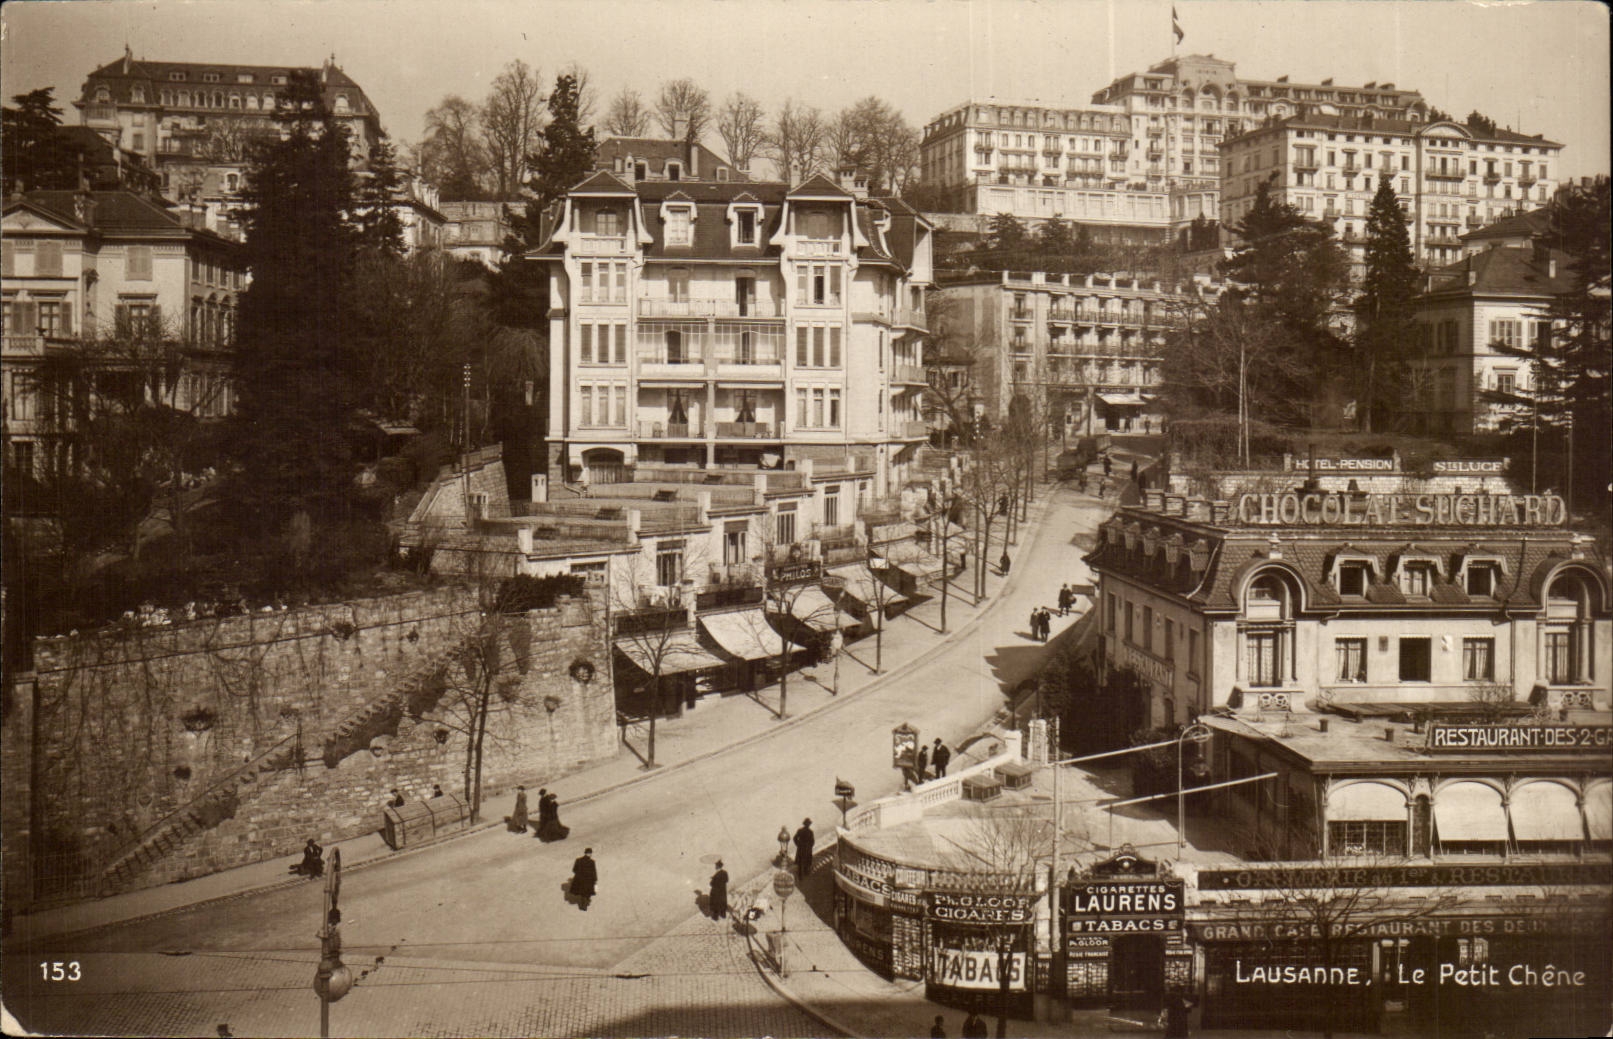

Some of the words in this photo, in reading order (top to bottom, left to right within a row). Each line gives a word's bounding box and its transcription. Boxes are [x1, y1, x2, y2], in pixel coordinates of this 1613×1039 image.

[1239, 493, 1403, 525] CHOCOLAT
[1415, 494, 1566, 526] SUCHARD
[1434, 727, 1541, 747] RESTAURANT
[1544, 727, 1577, 746] DES
[1580, 728, 1592, 746] 2
[841, 864, 893, 899] TABACS
[1086, 885, 1166, 895] CIGARETTES
[1075, 893, 1176, 913] LAURENS
[935, 906, 1024, 921] CIGARES
[1085, 919, 1165, 932] TABACS
[1203, 925, 1264, 940] GRAND
[1331, 920, 1451, 937] RESTAURANT
[1460, 920, 1495, 933] DES
